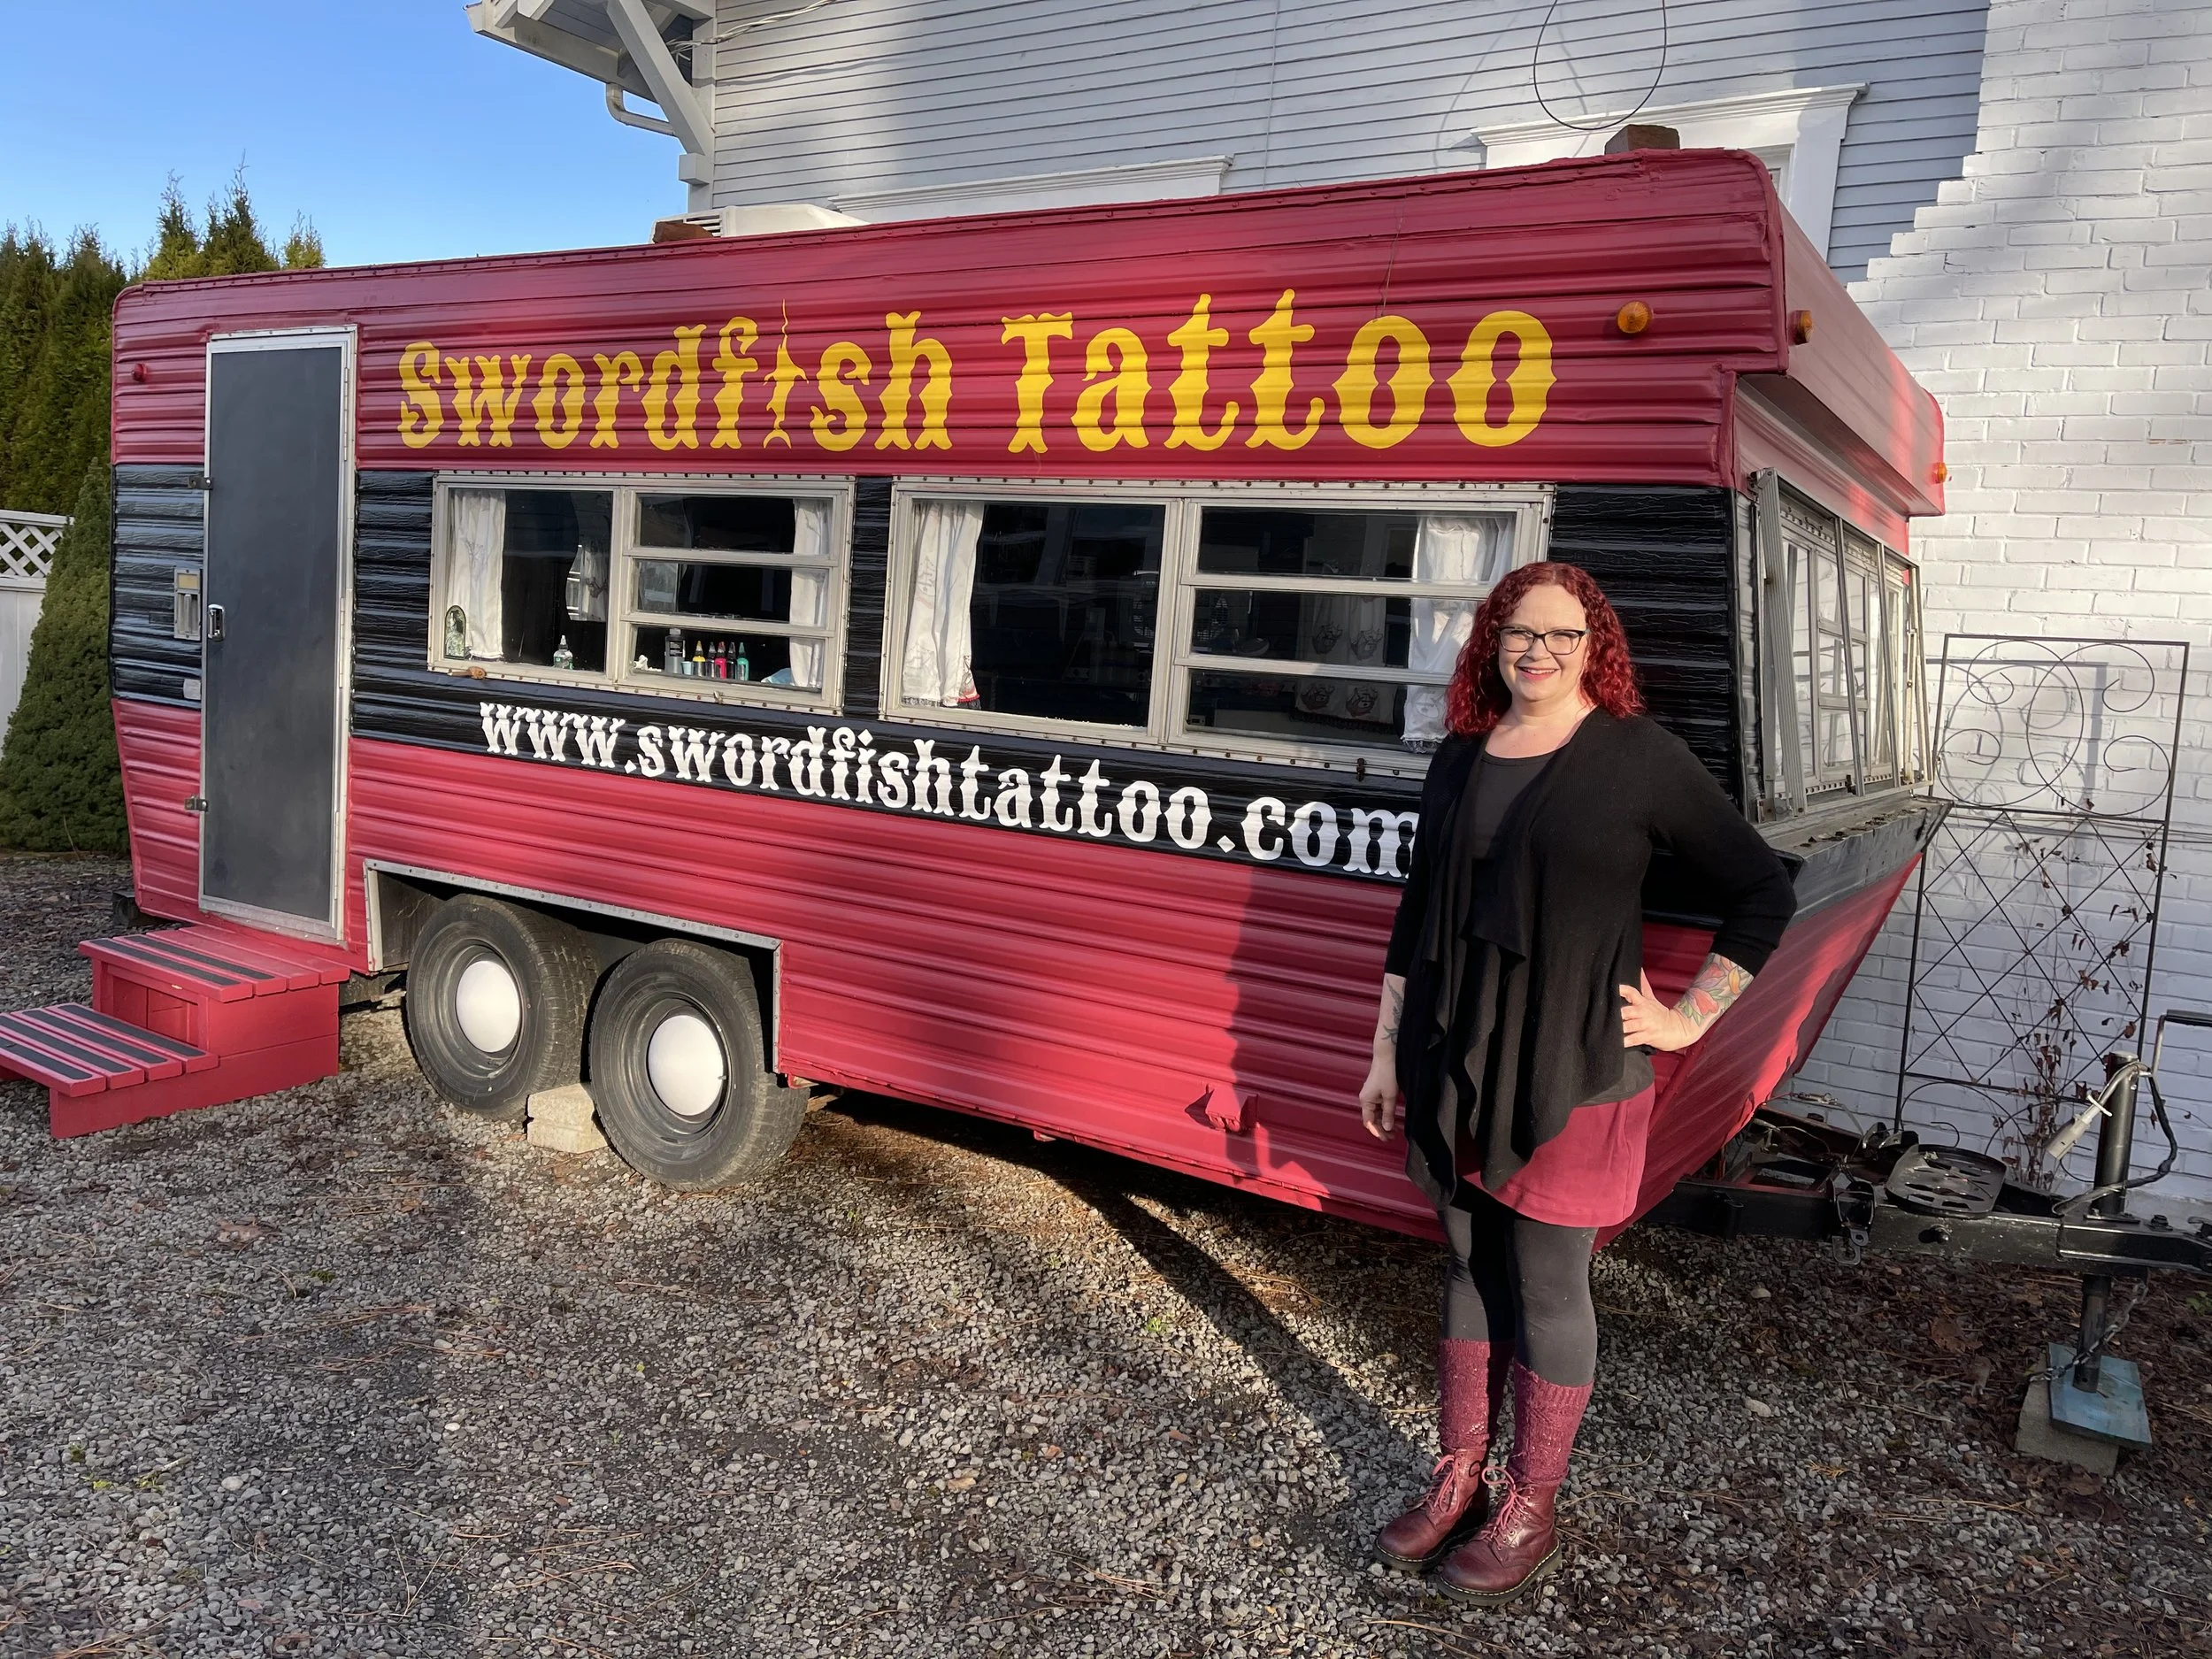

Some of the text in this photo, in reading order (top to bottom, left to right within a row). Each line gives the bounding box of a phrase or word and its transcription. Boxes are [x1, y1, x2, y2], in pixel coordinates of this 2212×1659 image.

[397, 288, 1557, 453] Swordfish Tattoo
[480, 702, 1419, 879] www.swordfishtattoo.com
